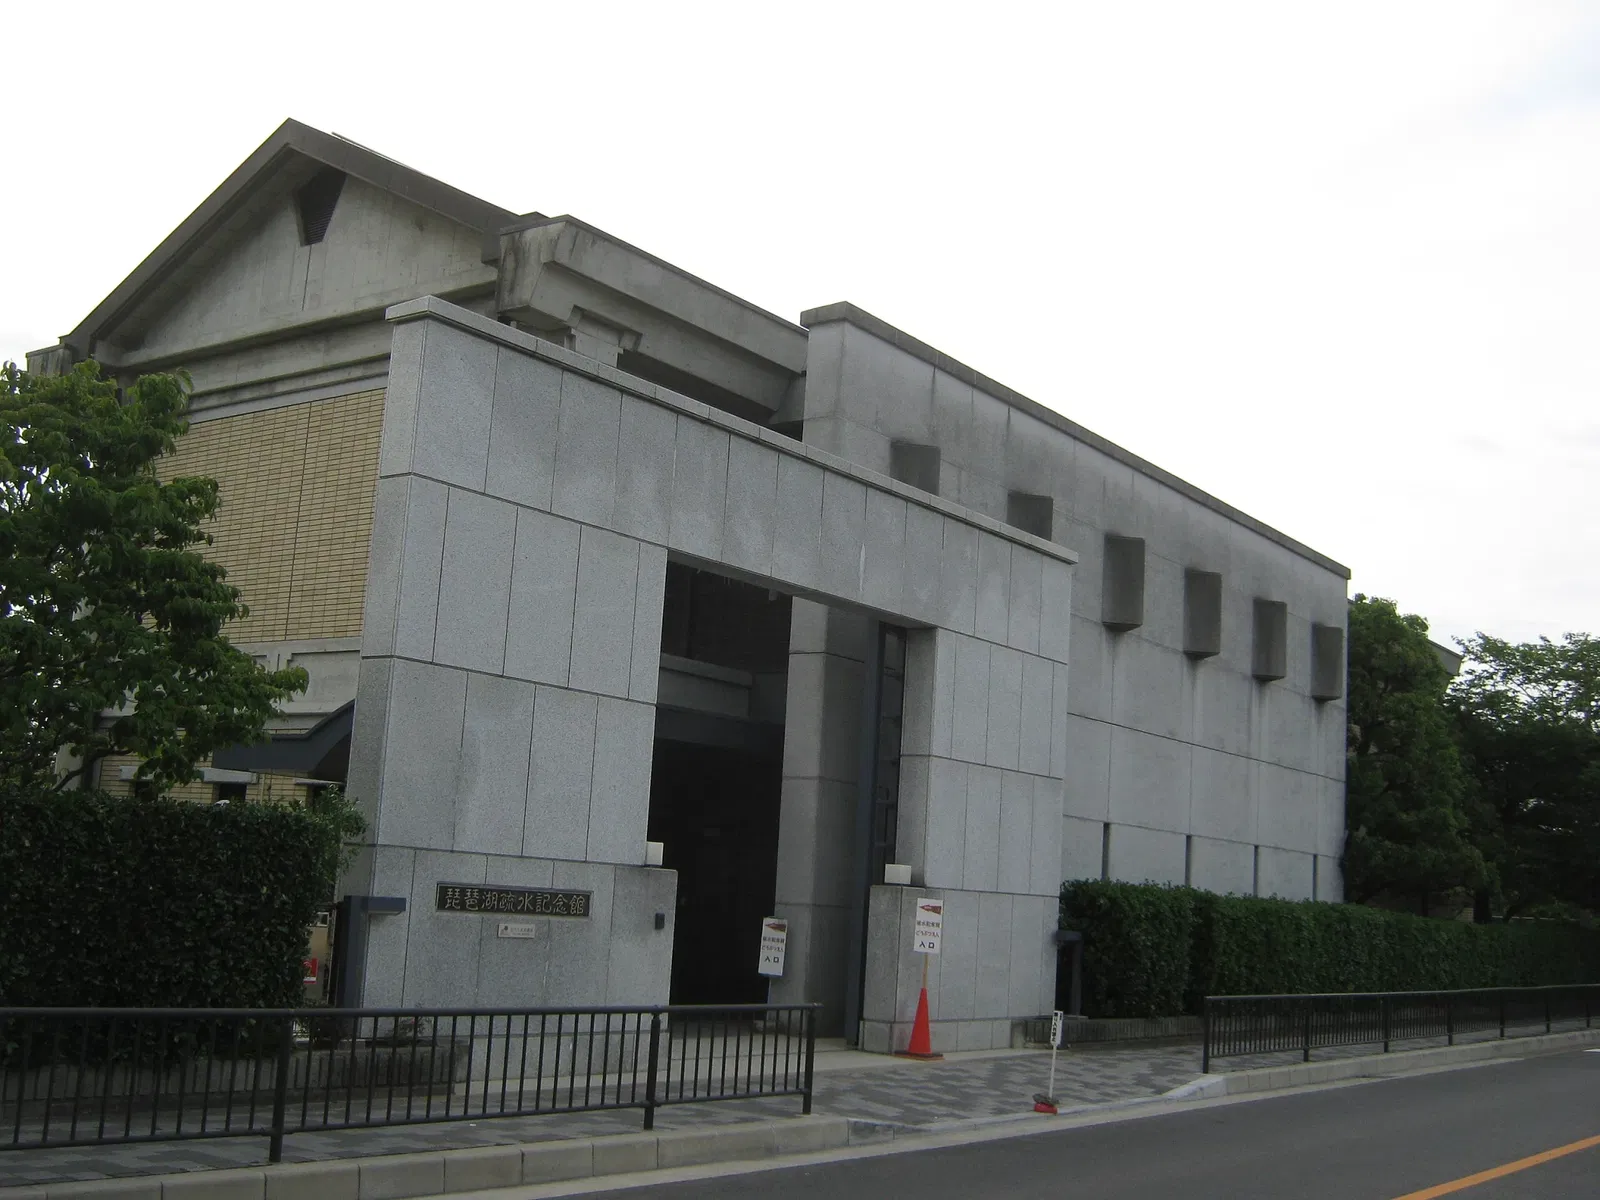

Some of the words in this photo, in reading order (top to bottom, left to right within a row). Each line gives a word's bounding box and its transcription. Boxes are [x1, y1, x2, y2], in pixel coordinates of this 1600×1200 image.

[444, 888, 585, 914] 琵琶湖疏水記念館
[919, 941, 935, 949] 入口
